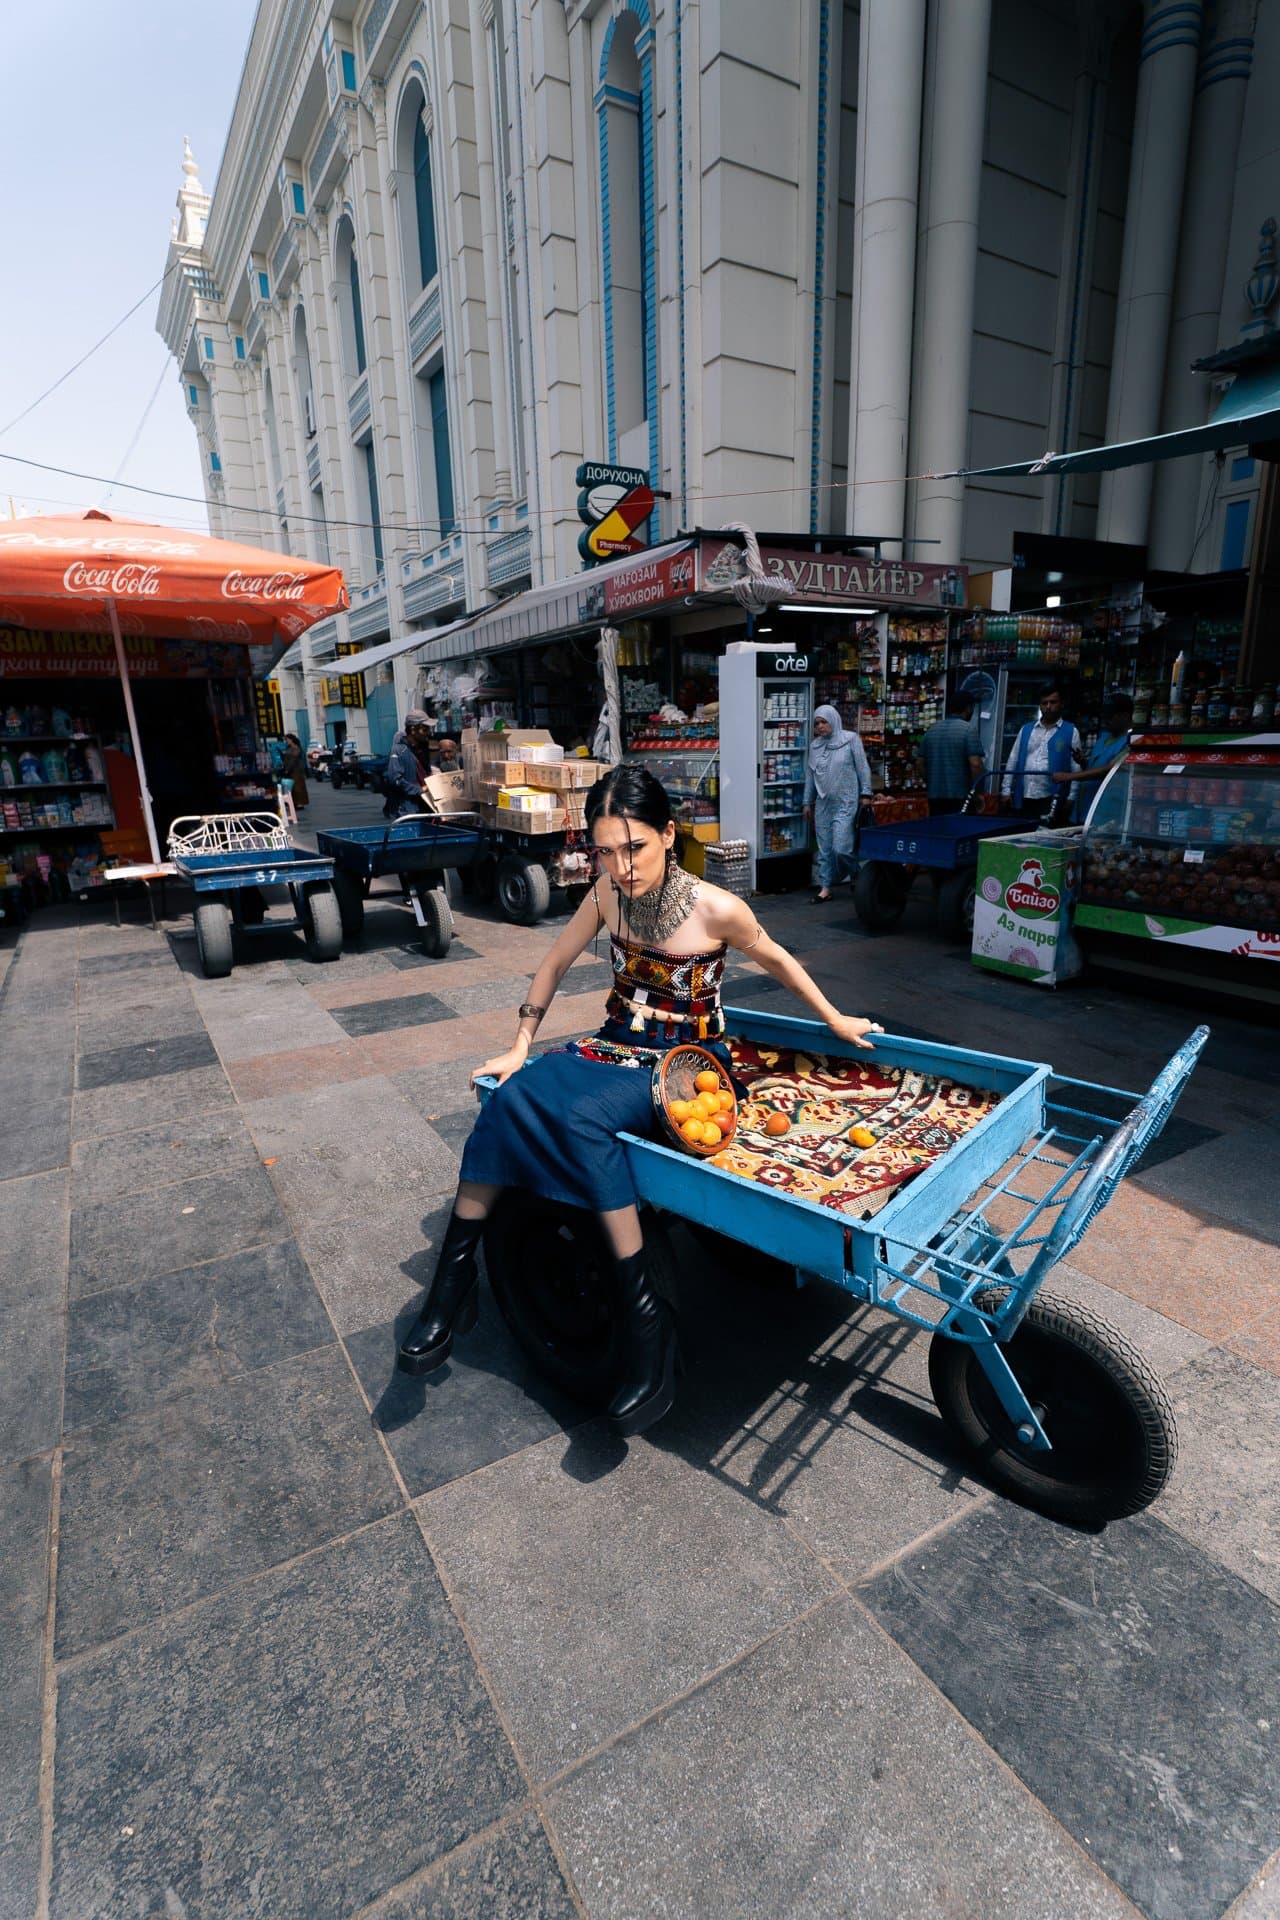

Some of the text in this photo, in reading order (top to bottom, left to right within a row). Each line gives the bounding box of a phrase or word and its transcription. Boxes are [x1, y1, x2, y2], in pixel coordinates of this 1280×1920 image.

[586, 466, 645, 486] ДОРУХОНА
[599, 541, 632, 552] Pharmacy
[64, 561, 163, 595] Coca-Cola
[221, 569, 309, 600] Coca-Cola
[767, 558, 925, 596] ЗУДТАЙЁР
[775, 654, 808, 672] artel
[1009, 888, 1057, 910] Байзо
[997, 912, 1015, 932] Аз
